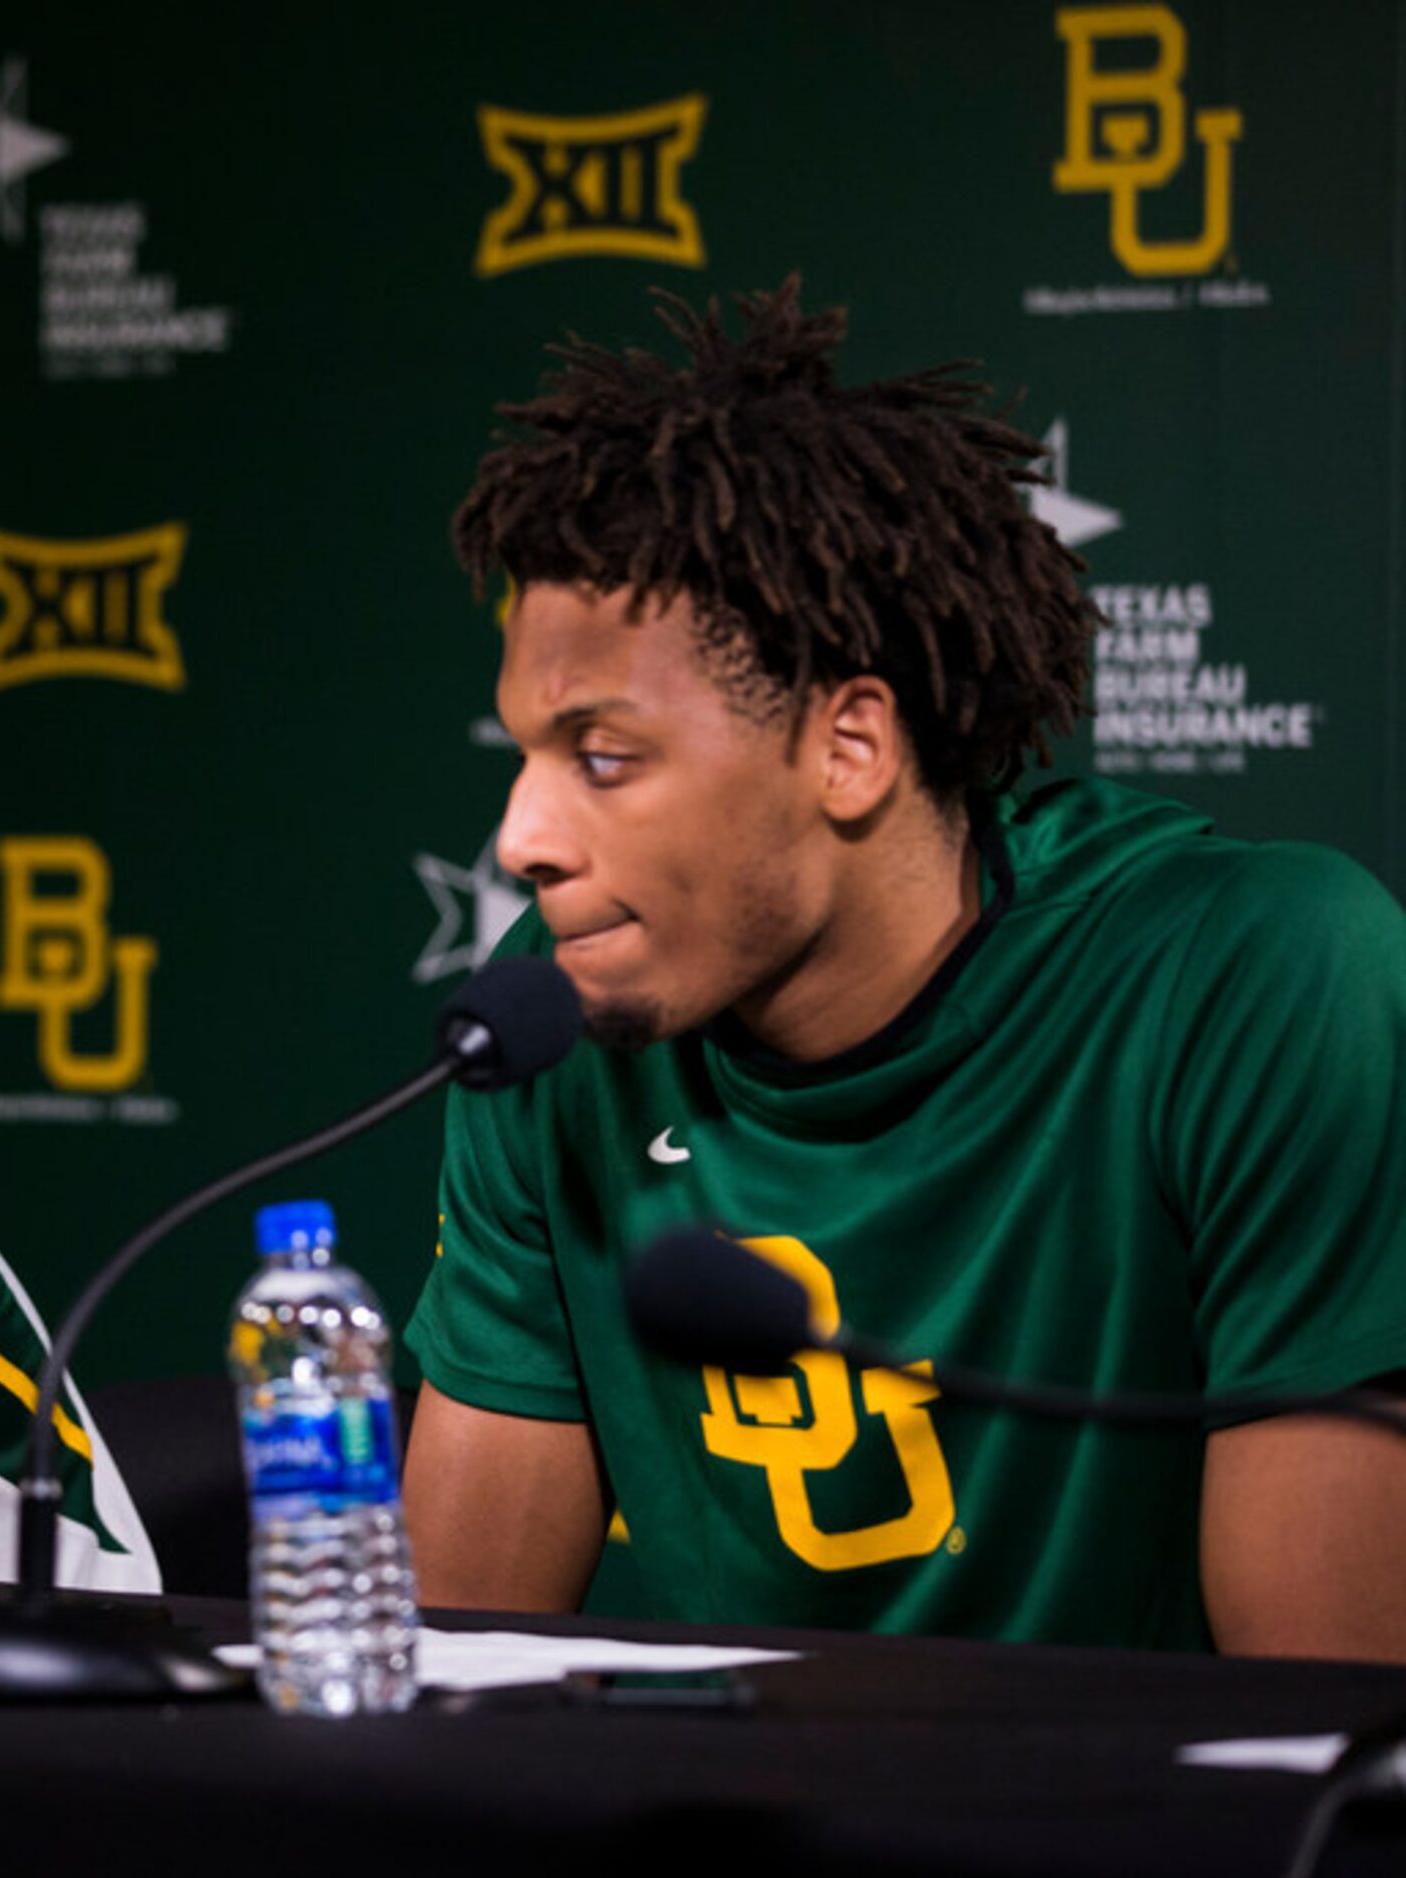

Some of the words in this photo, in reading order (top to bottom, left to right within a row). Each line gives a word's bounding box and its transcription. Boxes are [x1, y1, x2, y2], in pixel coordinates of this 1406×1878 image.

[1053, 3, 1244, 277] BU
[1092, 583, 1212, 628] TEXAS
[1095, 628, 1200, 664] FARM
[1095, 664, 1246, 706] BUREAU
[1095, 703, 1314, 748] INSURANCE
[699, 1235, 956, 1572] BU
